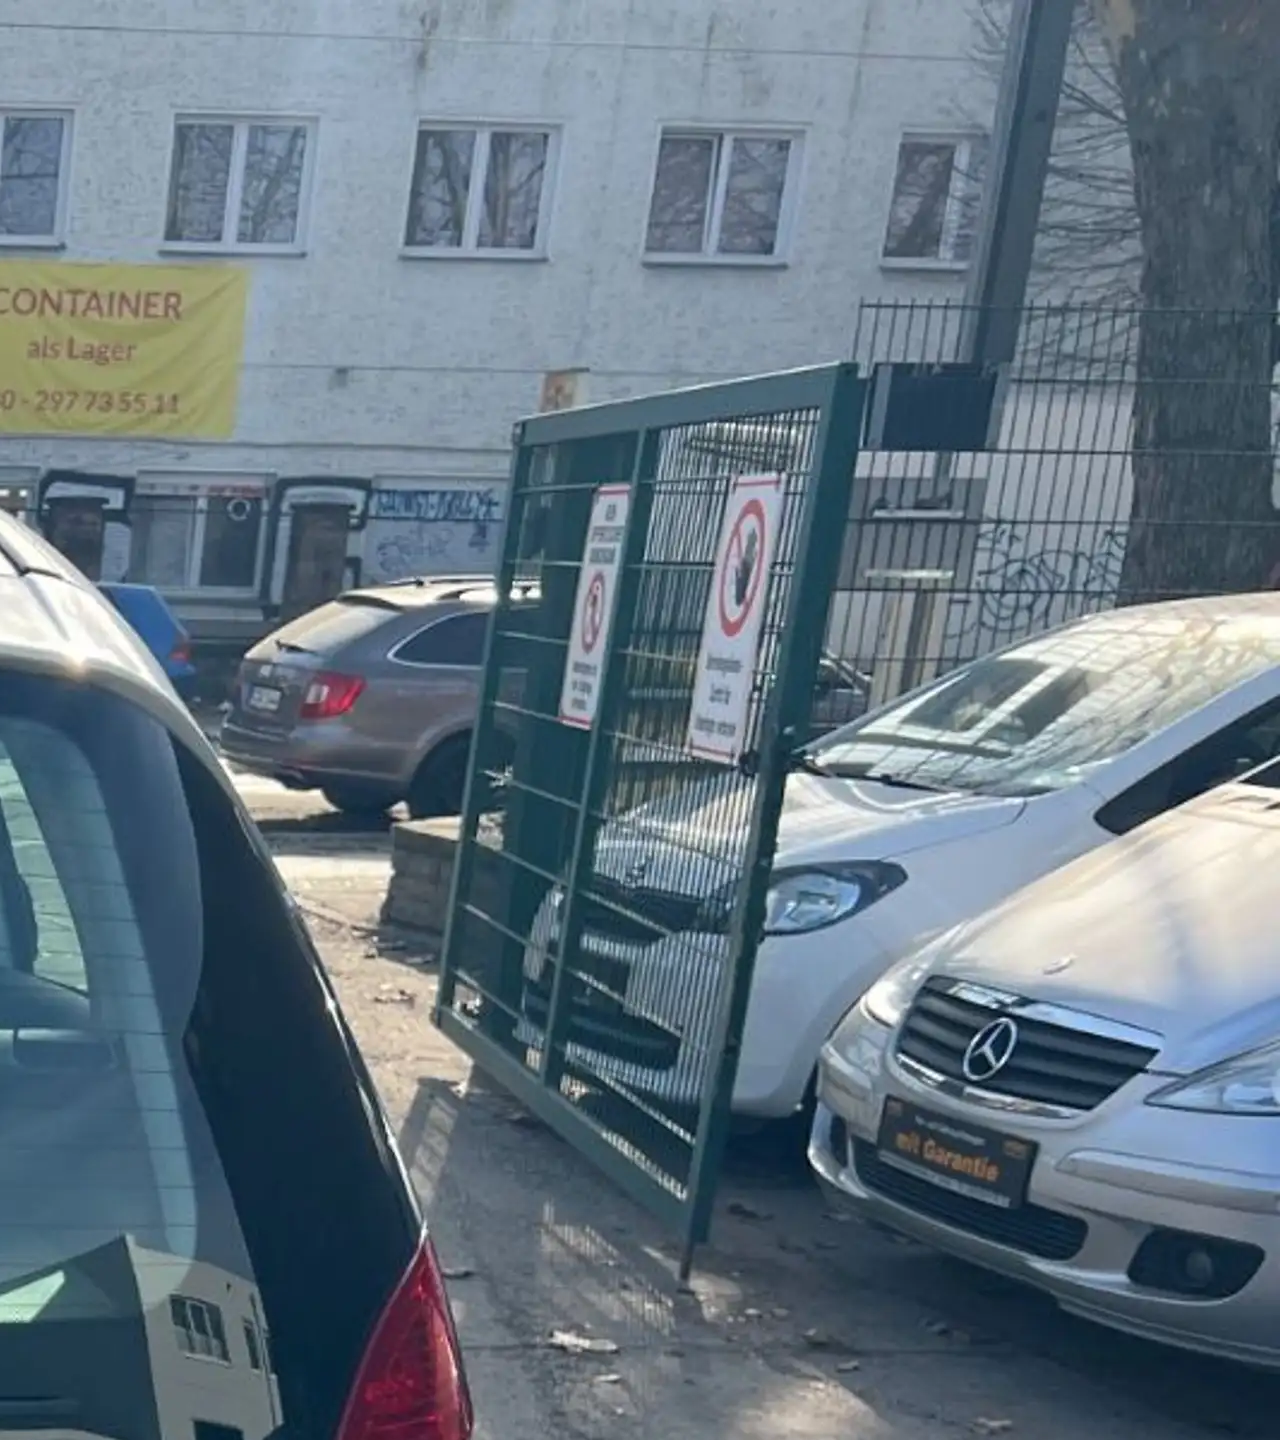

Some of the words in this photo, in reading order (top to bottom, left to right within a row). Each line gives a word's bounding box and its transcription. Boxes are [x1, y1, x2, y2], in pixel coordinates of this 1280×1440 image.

[27, 336, 62, 361] als
[66, 336, 138, 366] Lager
[34, 389, 80, 413] 297
